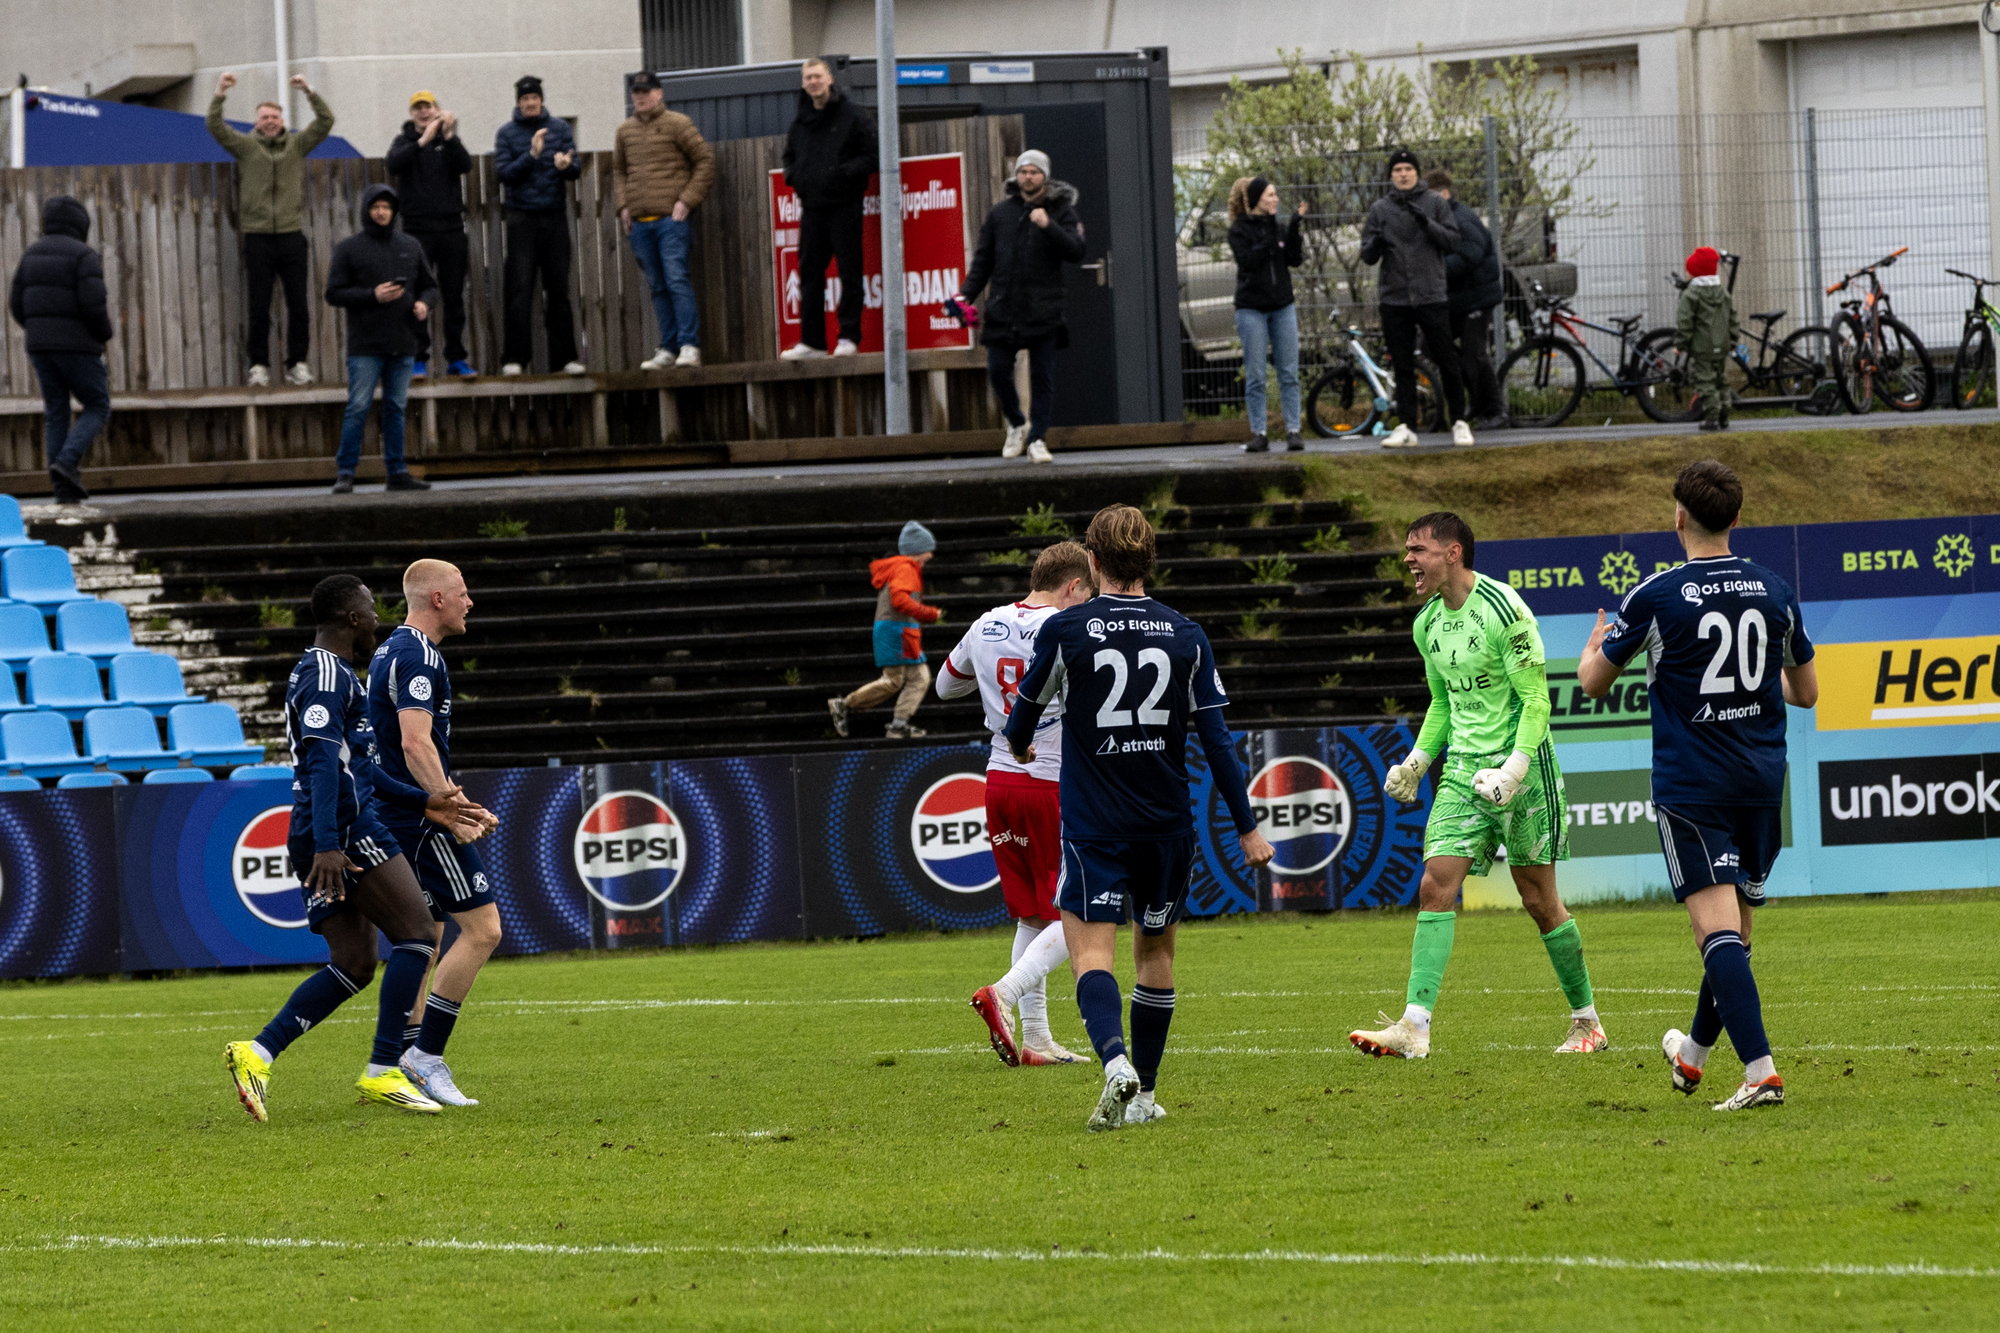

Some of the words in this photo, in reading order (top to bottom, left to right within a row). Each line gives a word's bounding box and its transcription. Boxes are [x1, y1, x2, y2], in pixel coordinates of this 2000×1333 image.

[777, 192, 803, 223] Velk
[1843, 549, 1919, 572] BESTA
[1508, 566, 1585, 590] BESTA
[1723, 580, 1766, 592] EIGNIR
[1128, 620, 1174, 632] EIGNIR
[1514, 641, 1532, 654] 24
[1697, 608, 1768, 695] 20
[997, 657, 1024, 715] 8
[1093, 647, 1171, 728] 22
[1446, 673, 1491, 693] LUE
[1717, 701, 1761, 721] atnorth
[1251, 802, 1343, 828] PEPSI
[582, 836, 678, 864] PEPSI
[1271, 880, 1327, 899] MAX
[606, 916, 663, 935] MAX
